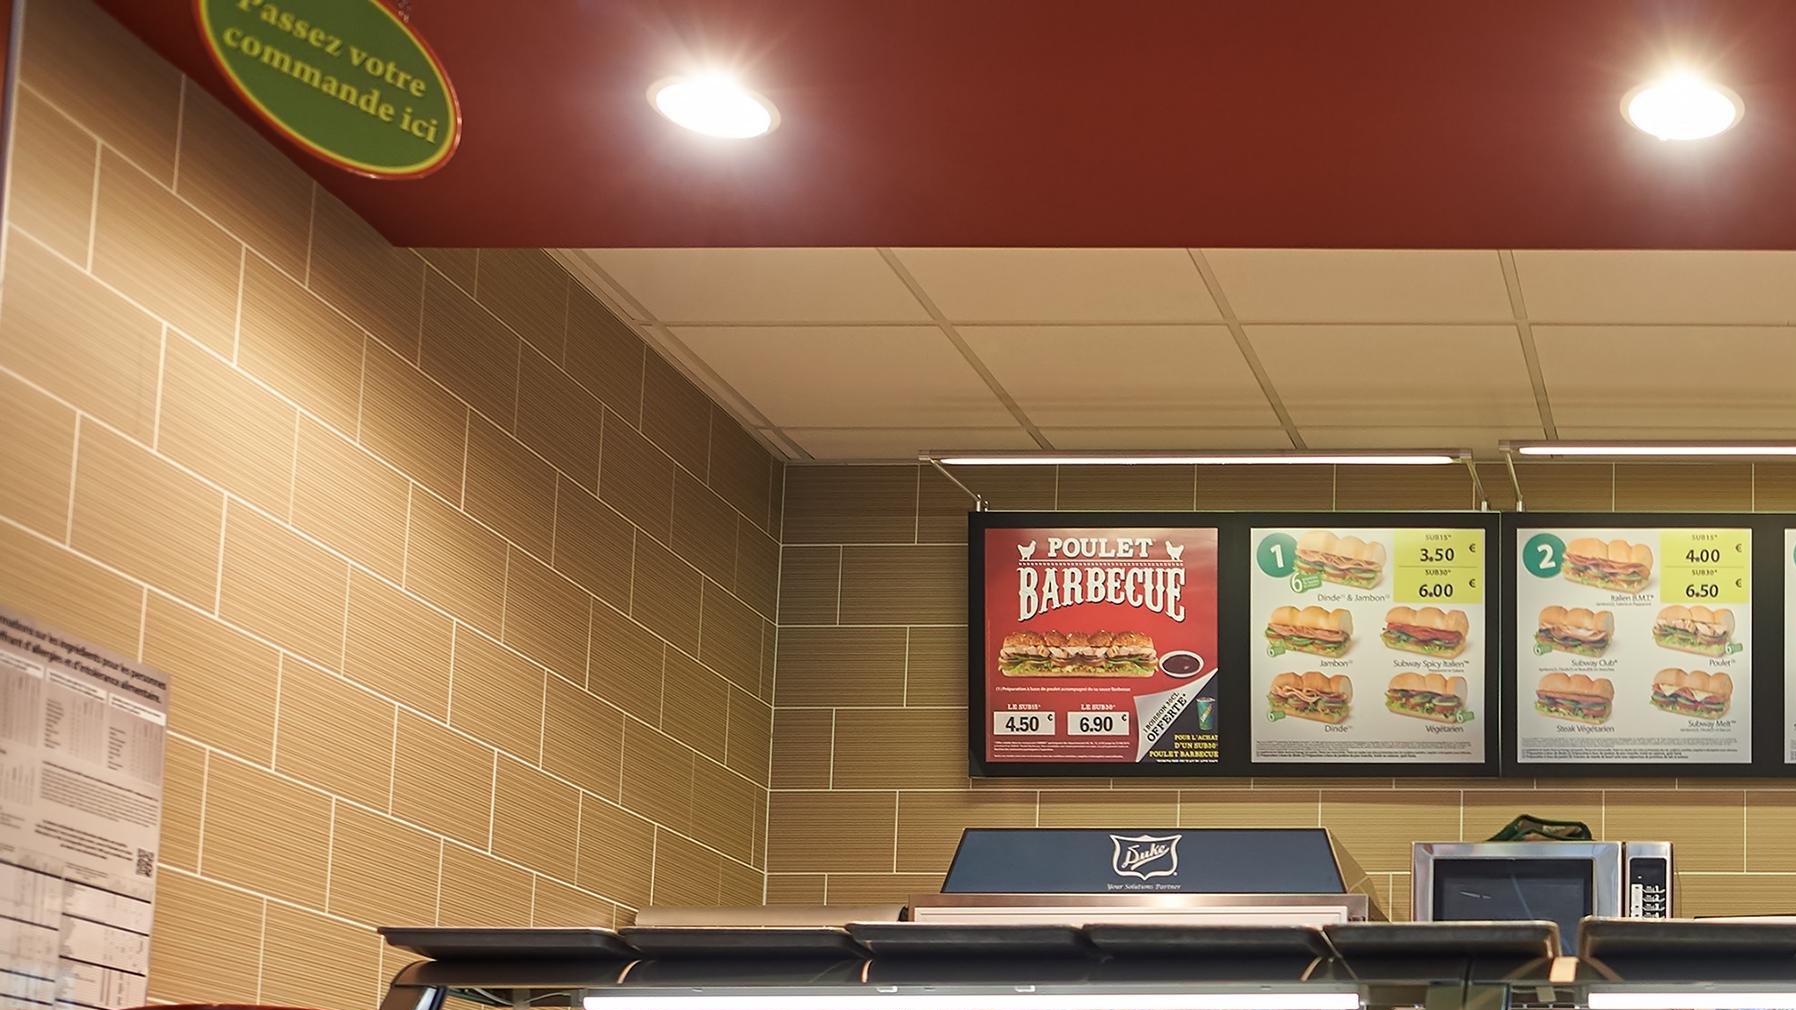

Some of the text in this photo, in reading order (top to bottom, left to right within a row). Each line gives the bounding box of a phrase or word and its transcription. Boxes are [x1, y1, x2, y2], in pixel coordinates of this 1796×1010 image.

[349, 47, 427, 97] votre
[222, 27, 440, 144] commande ici
[1048, 537, 1153, 557] POULET
[1420, 548, 1454, 562] 3.50
[1686, 549, 1720, 562] 4.00
[1270, 544, 1284, 568] 1
[1538, 544, 1556, 569] 2
[1017, 566, 1186, 622] BARBECUE
[1419, 583, 1453, 597] 6.00
[1686, 584, 1718, 598] 6.50
[1393, 660, 1421, 669] Subway
[1005, 716, 1039, 731] 4.50
[1080, 716, 1113, 731] 6.90
[1121, 844, 1170, 869] Duke
